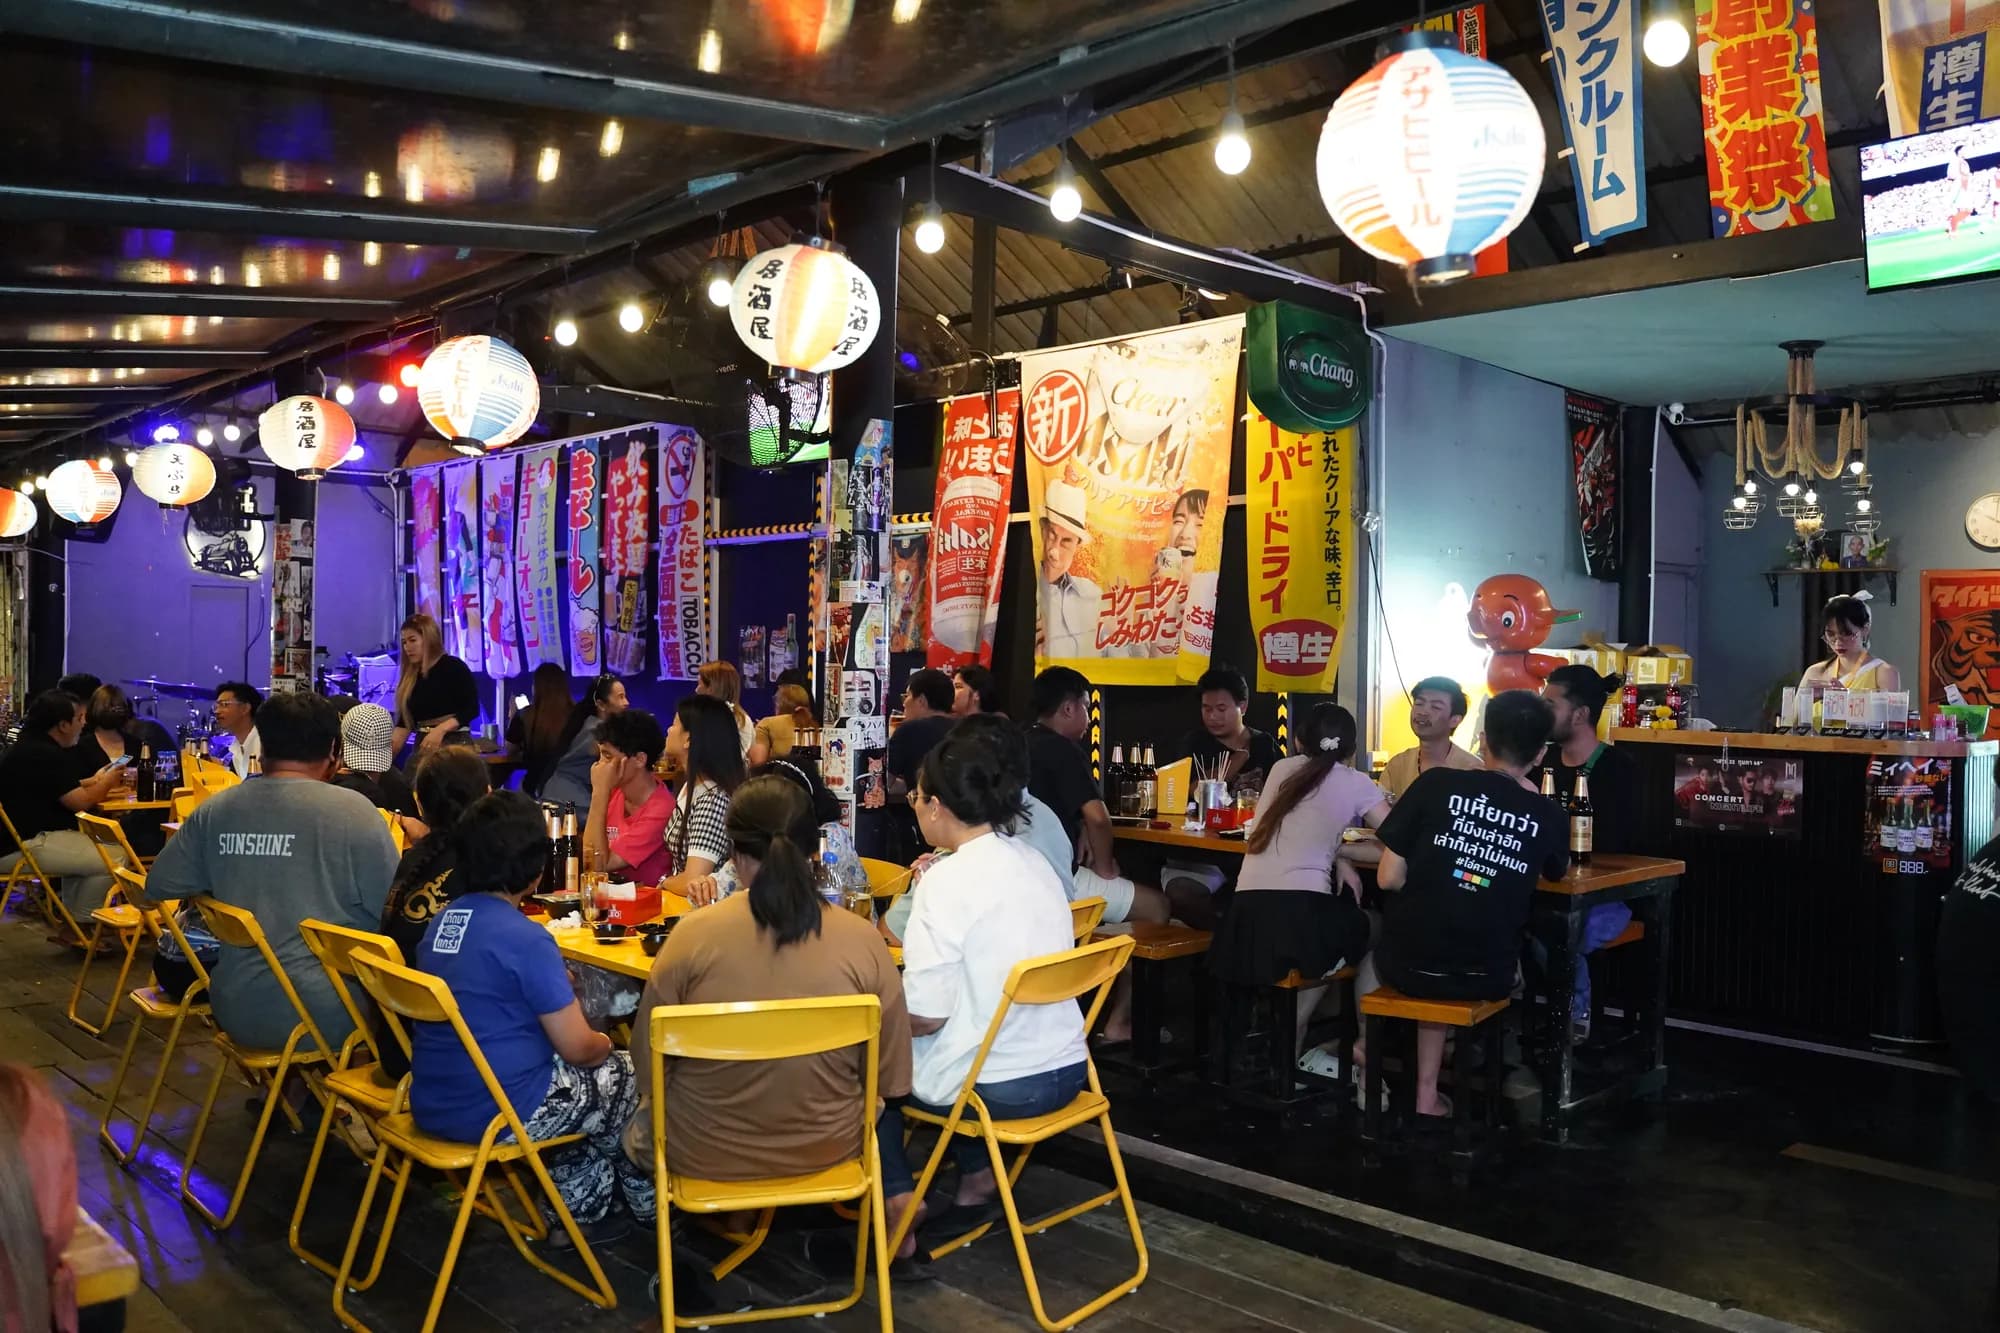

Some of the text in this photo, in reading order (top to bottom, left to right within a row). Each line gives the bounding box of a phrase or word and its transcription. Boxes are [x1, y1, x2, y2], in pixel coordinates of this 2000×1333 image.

[1925, 41, 1981, 132] 樽生
[1400, 65, 1441, 228] アサヒビール
[747, 259, 784, 340] 居酒屋
[1309, 352, 1354, 388] Chang
[296, 401, 317, 449] 居酒屋
[1031, 380, 1079, 455] 新
[1258, 413, 1294, 614] ーパードライ
[1322, 430, 1342, 613] れたクリアな味、辛口。
[679, 524, 700, 592] たばこ
[683, 598, 700, 677] TOBACCO
[1262, 632, 1334, 665] 樽生
[1448, 794, 1539, 837] กูเหี้ยกว่า
[1694, 793, 1744, 804] CONCERT
[218, 833, 296, 856] SUNSHINE
[1452, 815, 1522, 852] ที่มึงเล่าอีก
